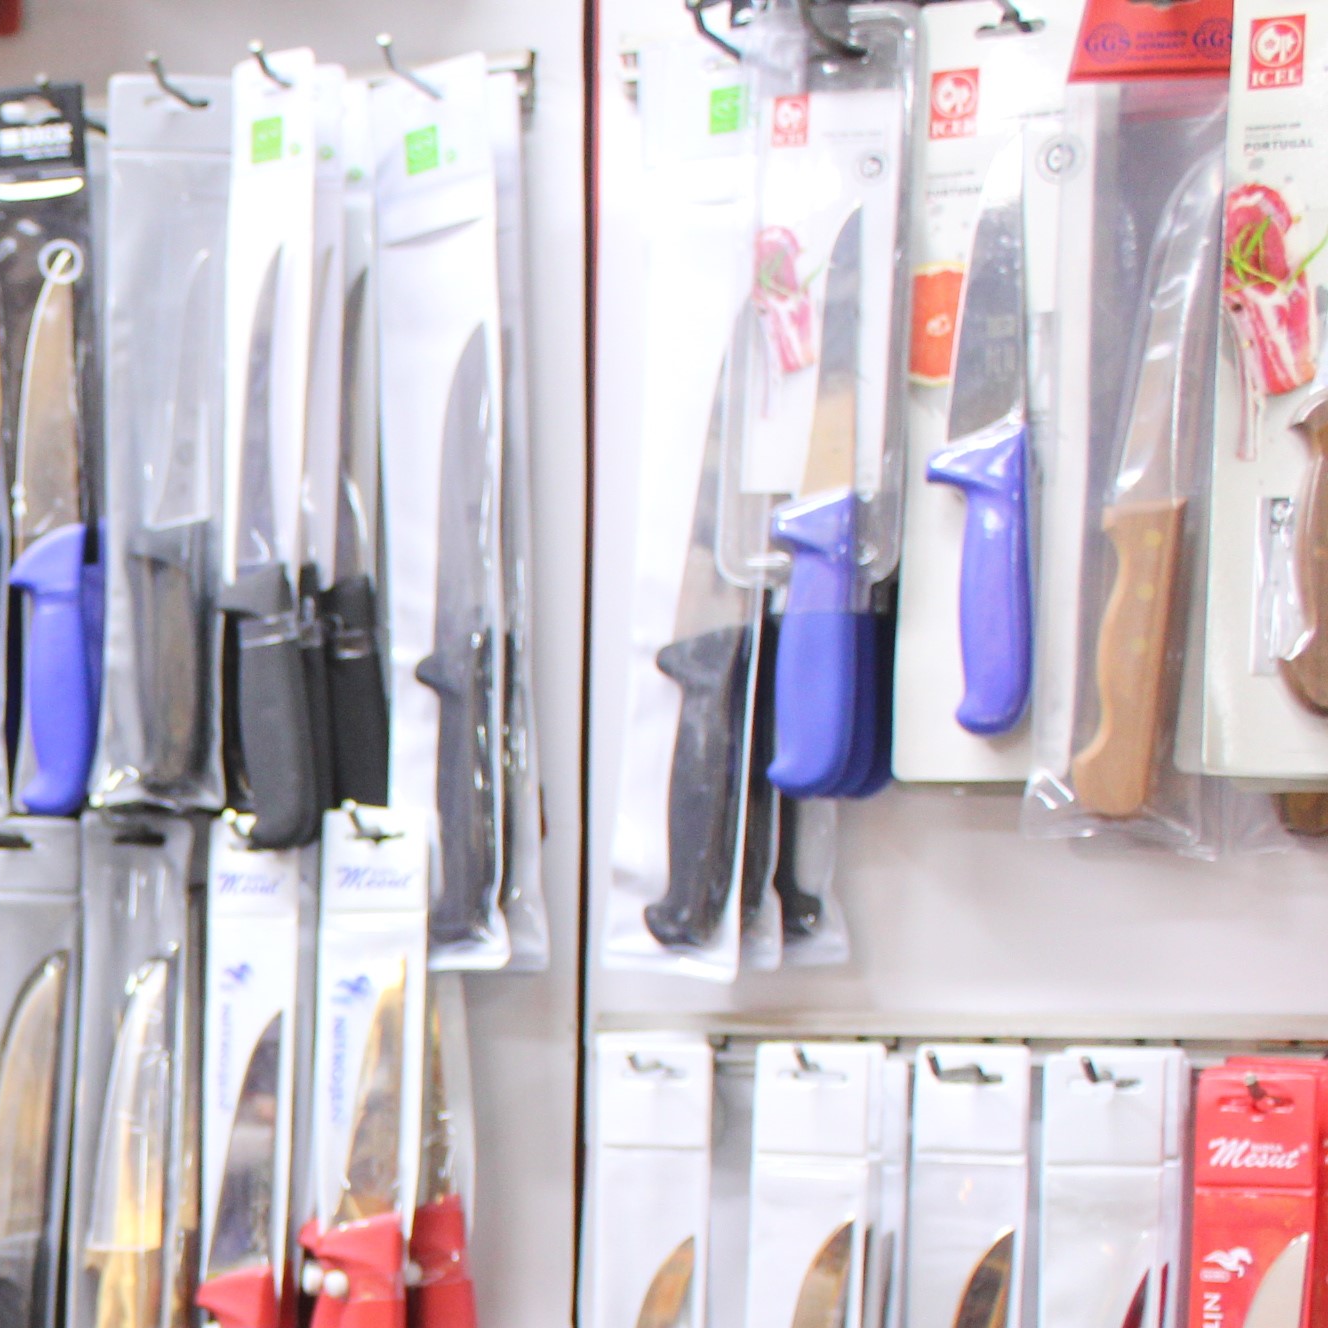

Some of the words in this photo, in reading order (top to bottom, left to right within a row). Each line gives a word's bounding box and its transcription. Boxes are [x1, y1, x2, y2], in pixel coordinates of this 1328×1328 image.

[1251, 68, 1300, 87] ICEL
[1243, 138, 1314, 152] PORTUGAL
[1208, 1137, 1300, 1170] Mesut
